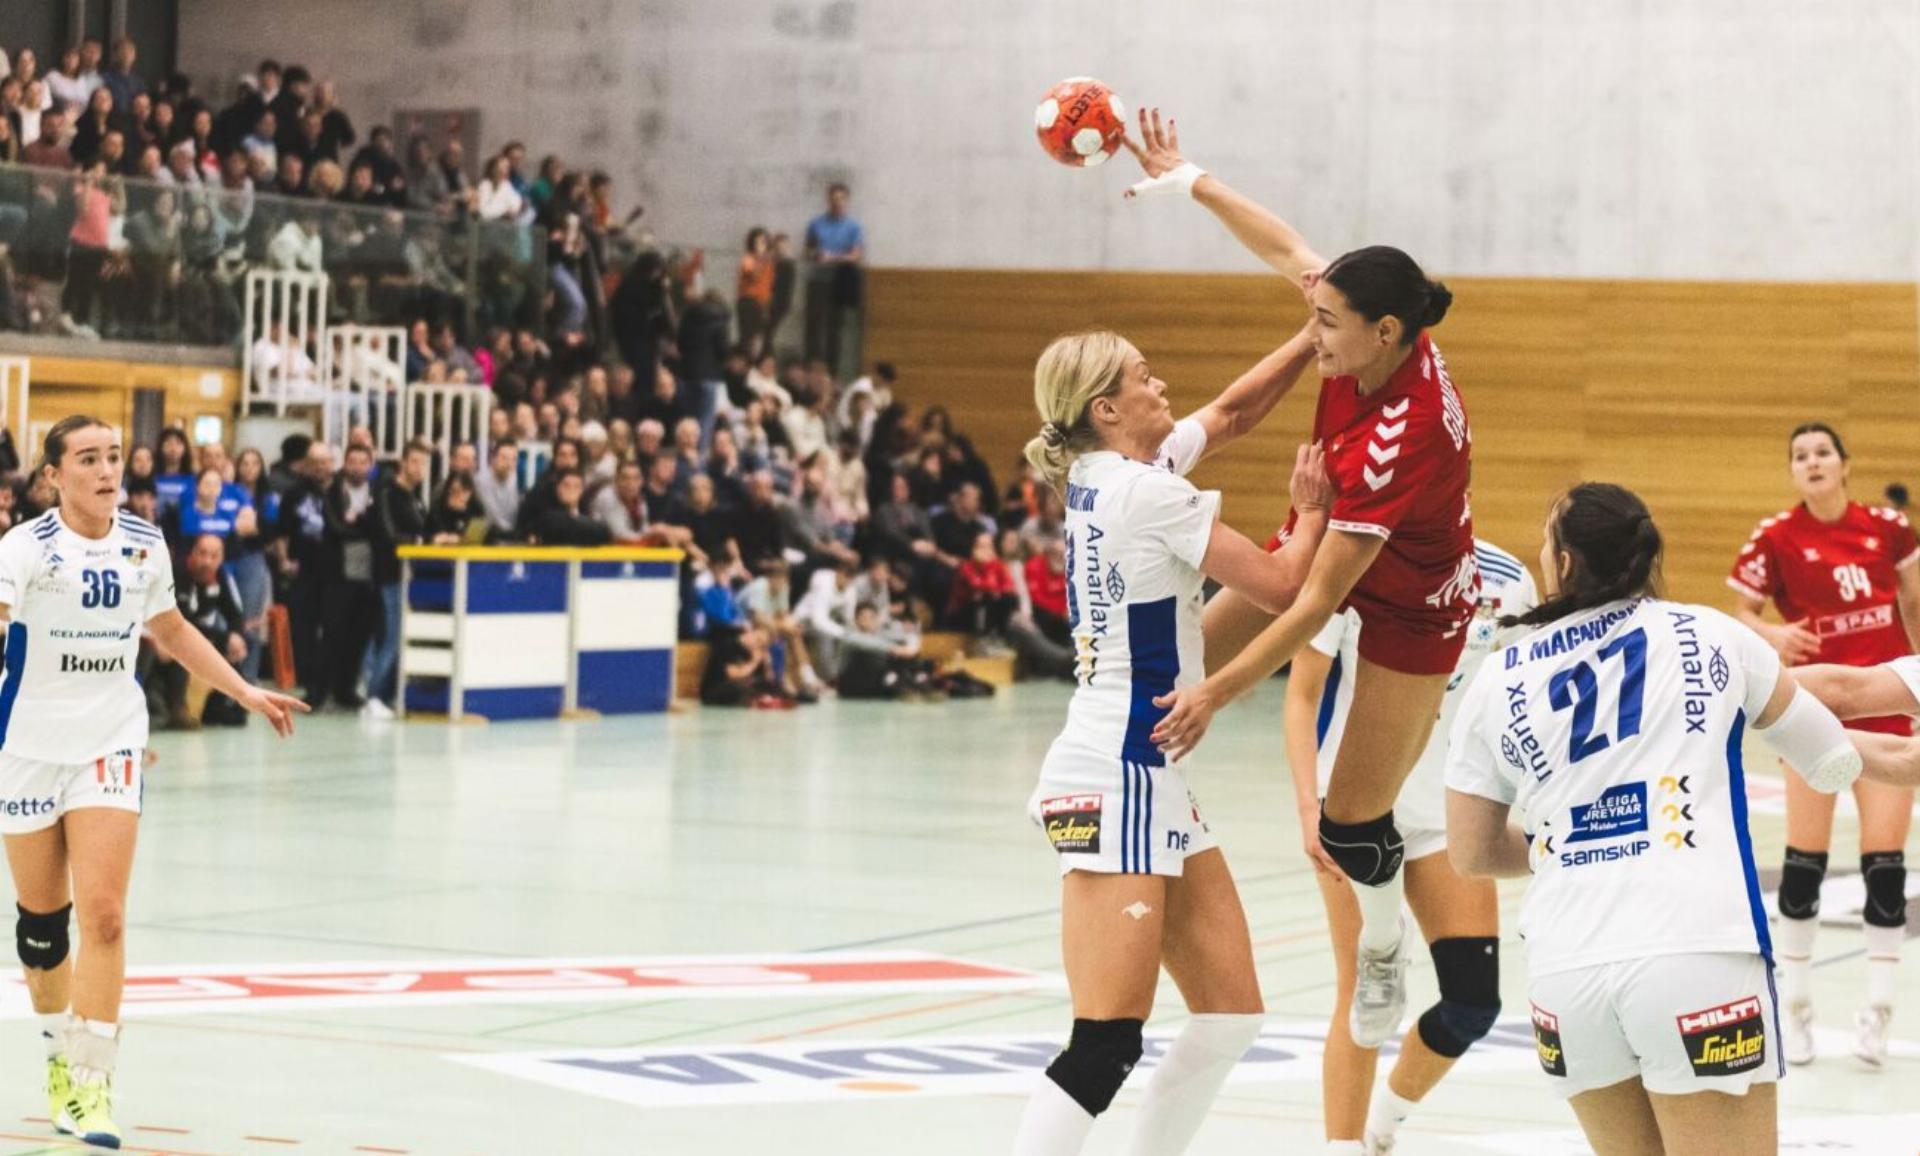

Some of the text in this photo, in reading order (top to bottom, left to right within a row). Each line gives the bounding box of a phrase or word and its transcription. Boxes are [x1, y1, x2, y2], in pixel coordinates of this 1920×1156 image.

[82, 569, 121, 608] 36
[1087, 524, 1111, 635] Arnarlax
[1833, 563, 1873, 602] 34
[50, 629, 120, 639] ICELANDAIR
[1833, 606, 1892, 634] SPAR
[1505, 646, 1524, 671] D.
[1668, 611, 1713, 735] Arnarlax
[1548, 627, 1648, 764] 27
[1681, 999, 1760, 1032] HILTI
